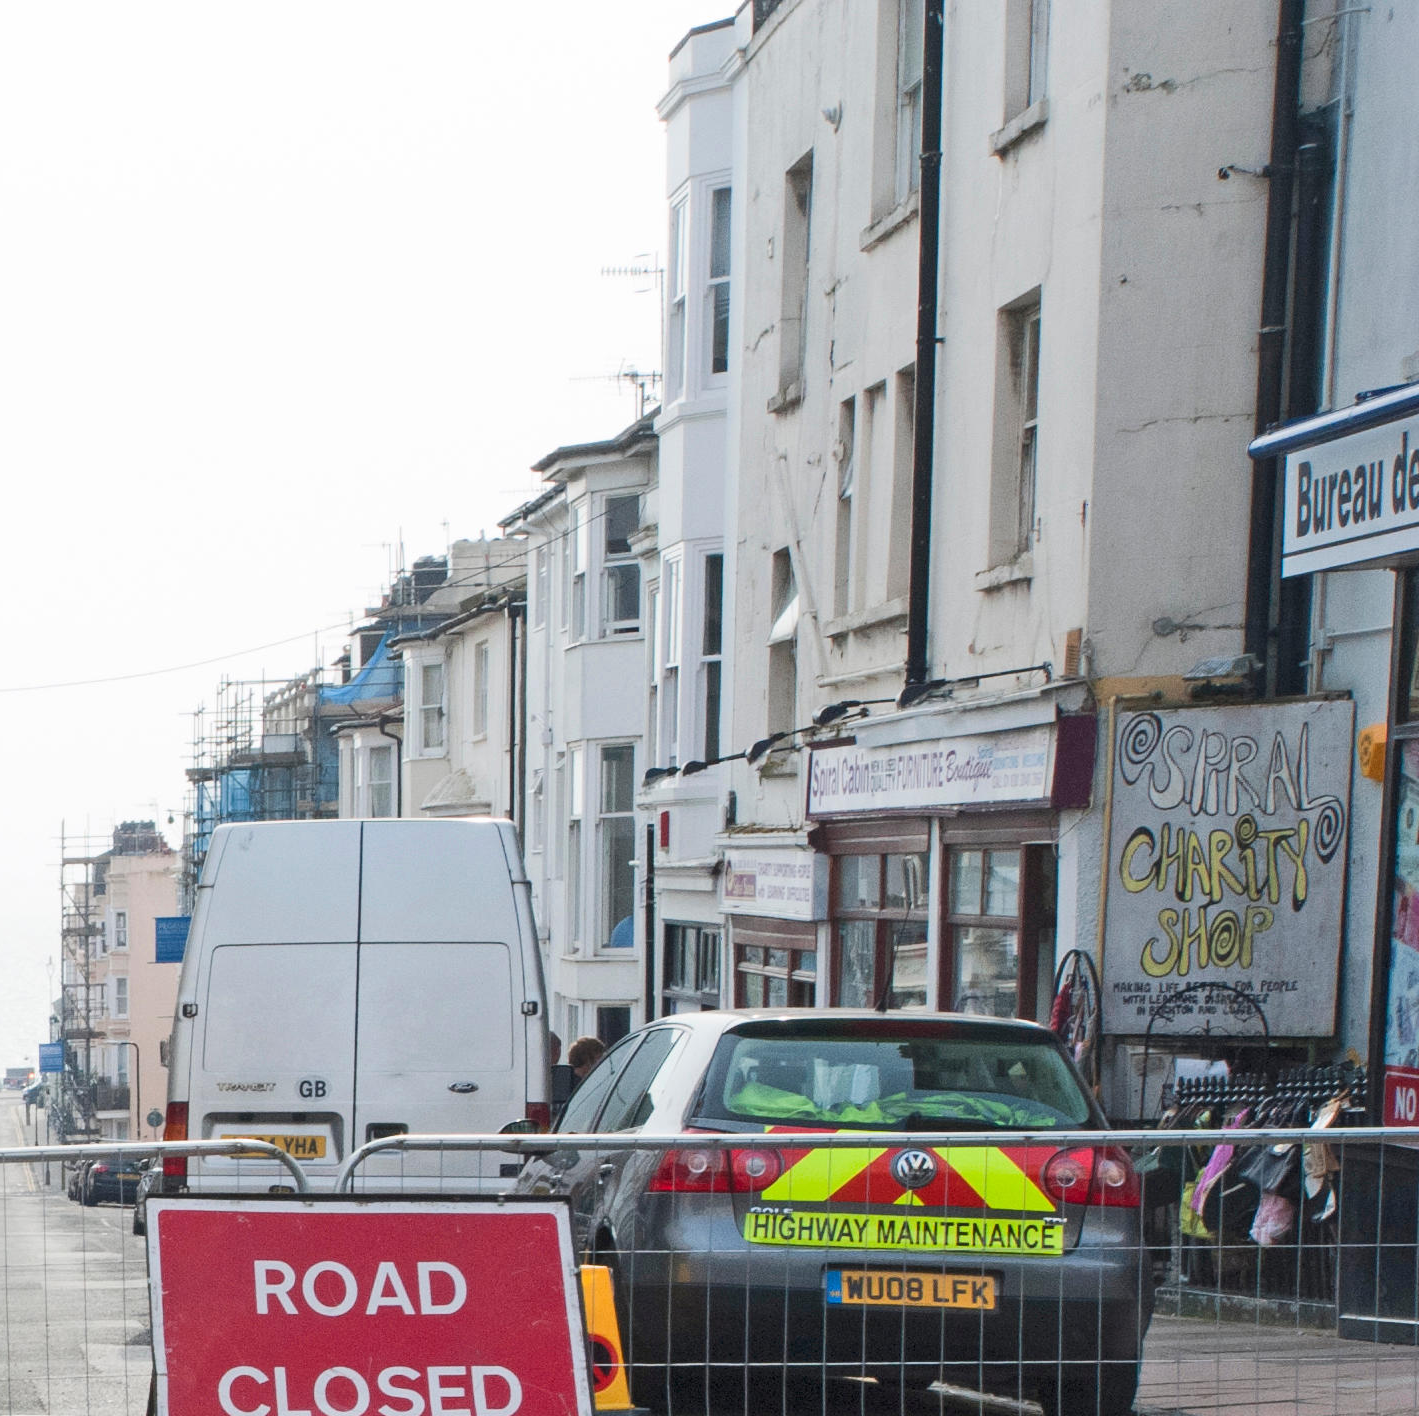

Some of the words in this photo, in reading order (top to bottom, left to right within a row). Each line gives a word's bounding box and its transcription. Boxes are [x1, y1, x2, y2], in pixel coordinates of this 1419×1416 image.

[1296, 460, 1383, 538] Bureau
[812, 755, 842, 806] Spiral
[841, 747, 871, 796] Cabin
[896, 752, 944, 790] FURNITURE
[945, 749, 993, 792] Boutique
[1120, 713, 1344, 817] SPIRAL
[1139, 904, 1275, 978] SHOP
[299, 1079, 327, 1098] GB
[1394, 1085, 1417, 1121] NO
[283, 1136, 318, 1155] YHA
[752, 1214, 870, 1244] HIGHWAY
[876, 1218, 1056, 1249] MAINTENANCE
[253, 1259, 468, 1317] ROAD
[846, 1275, 924, 1302] WU08
[932, 1279, 989, 1305] LFK
